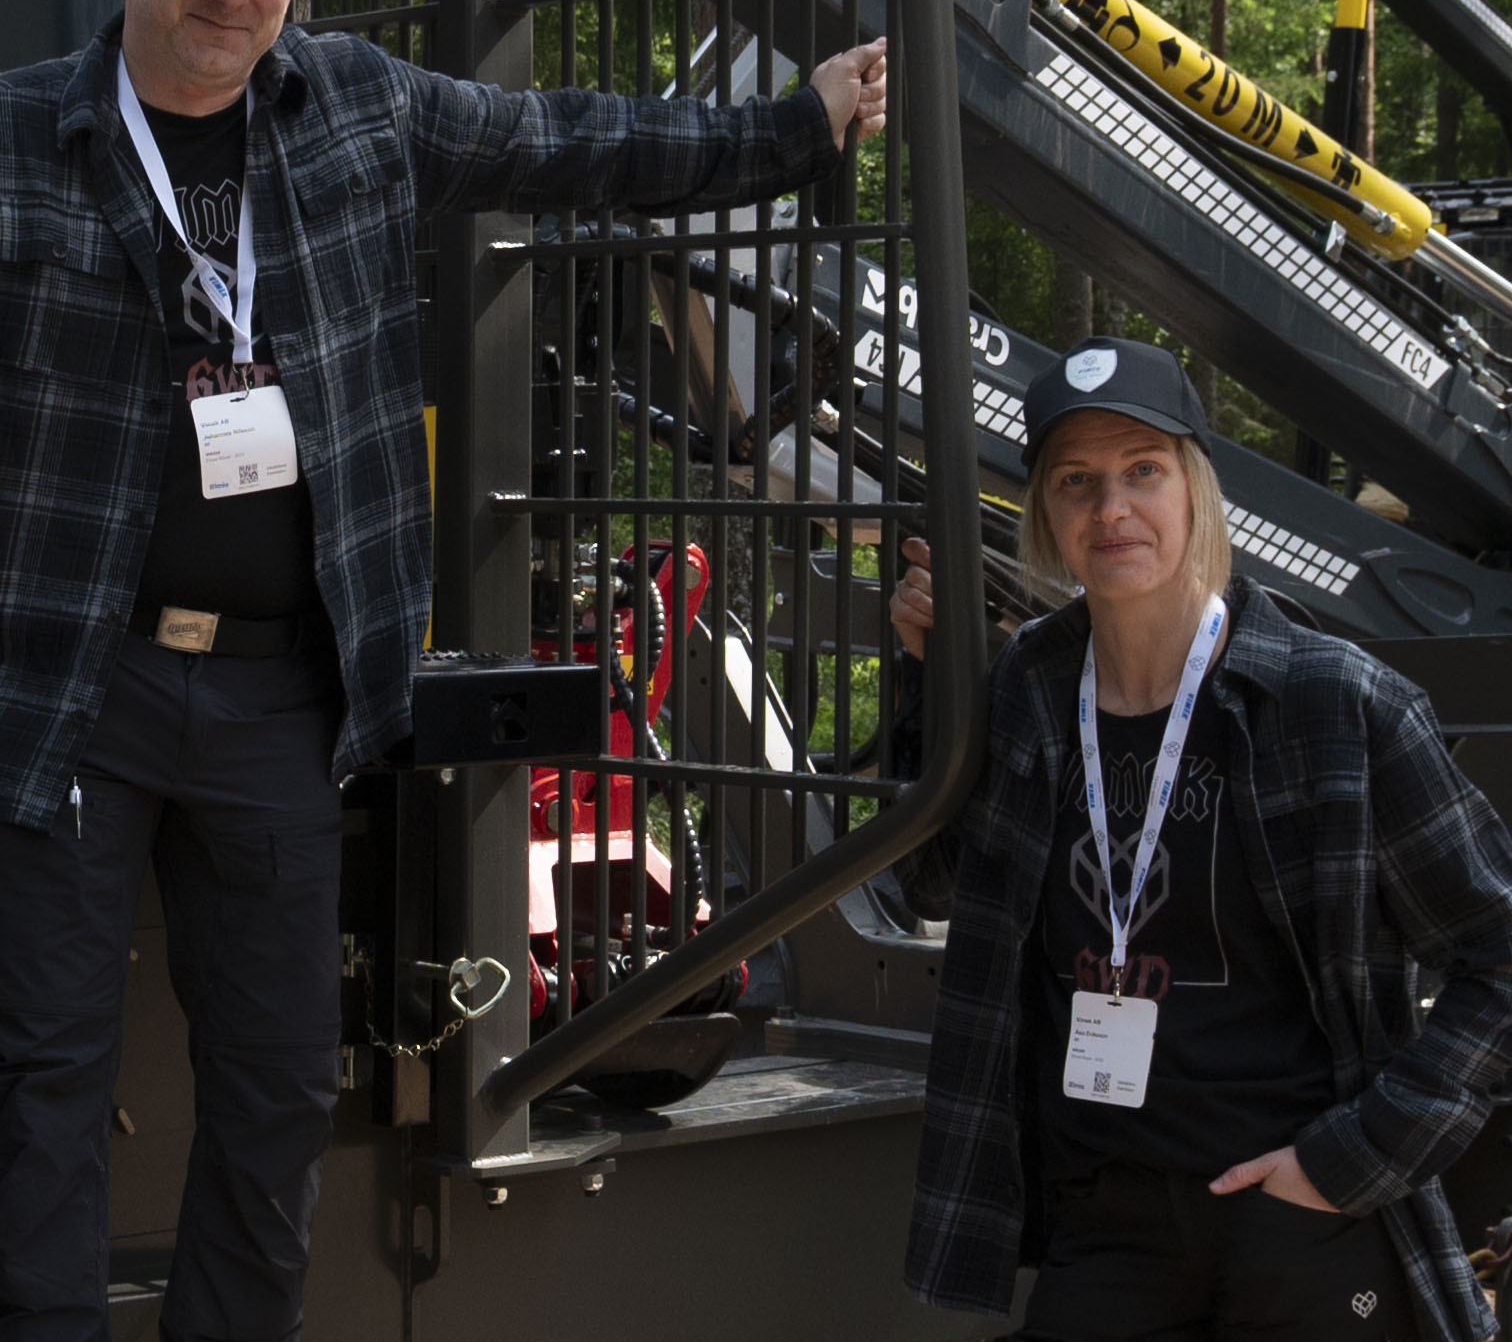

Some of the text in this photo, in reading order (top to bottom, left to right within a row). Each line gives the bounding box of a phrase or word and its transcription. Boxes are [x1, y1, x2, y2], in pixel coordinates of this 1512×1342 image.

[1184, 50, 1283, 148] 20 M
[1400, 340, 1432, 381] FC4
